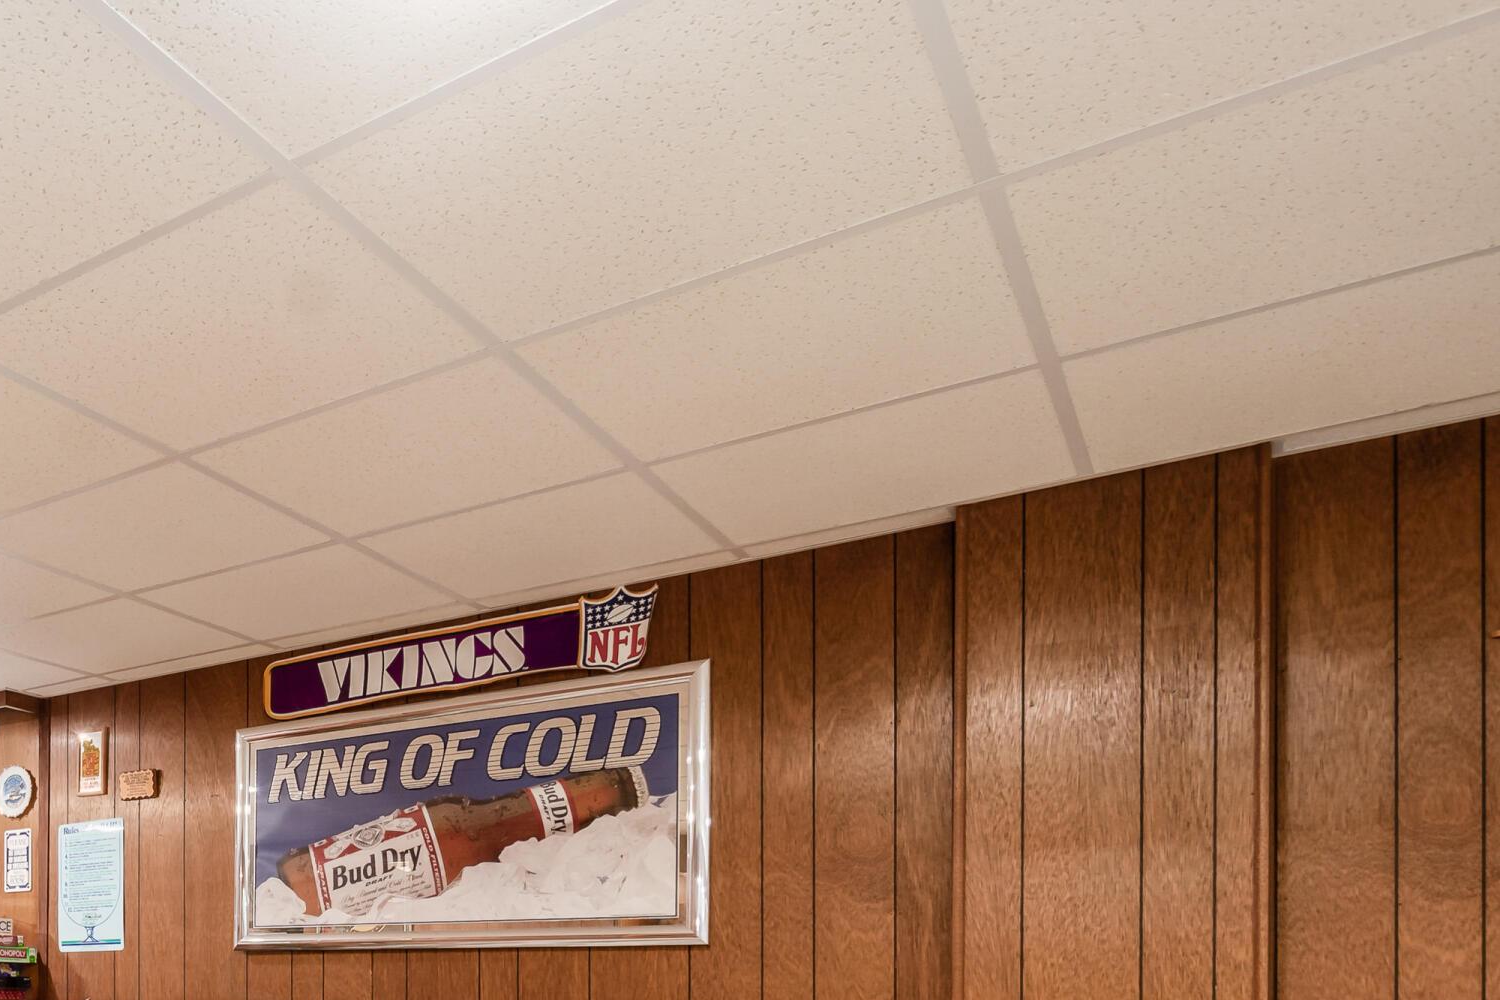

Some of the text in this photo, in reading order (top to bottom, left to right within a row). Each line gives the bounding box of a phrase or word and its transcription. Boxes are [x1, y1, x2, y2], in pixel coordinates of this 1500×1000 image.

[317, 626, 526, 703] VIKINGS
[587, 624, 647, 664] NFL
[268, 706, 662, 804] KING OF COLD
[539, 781, 569, 834] Bud Dry
[63, 827, 80, 835] Rules
[423, 826, 434, 852] COLD
[332, 845, 423, 891] Bud Dry
[365, 874, 394, 888] DRAFT
